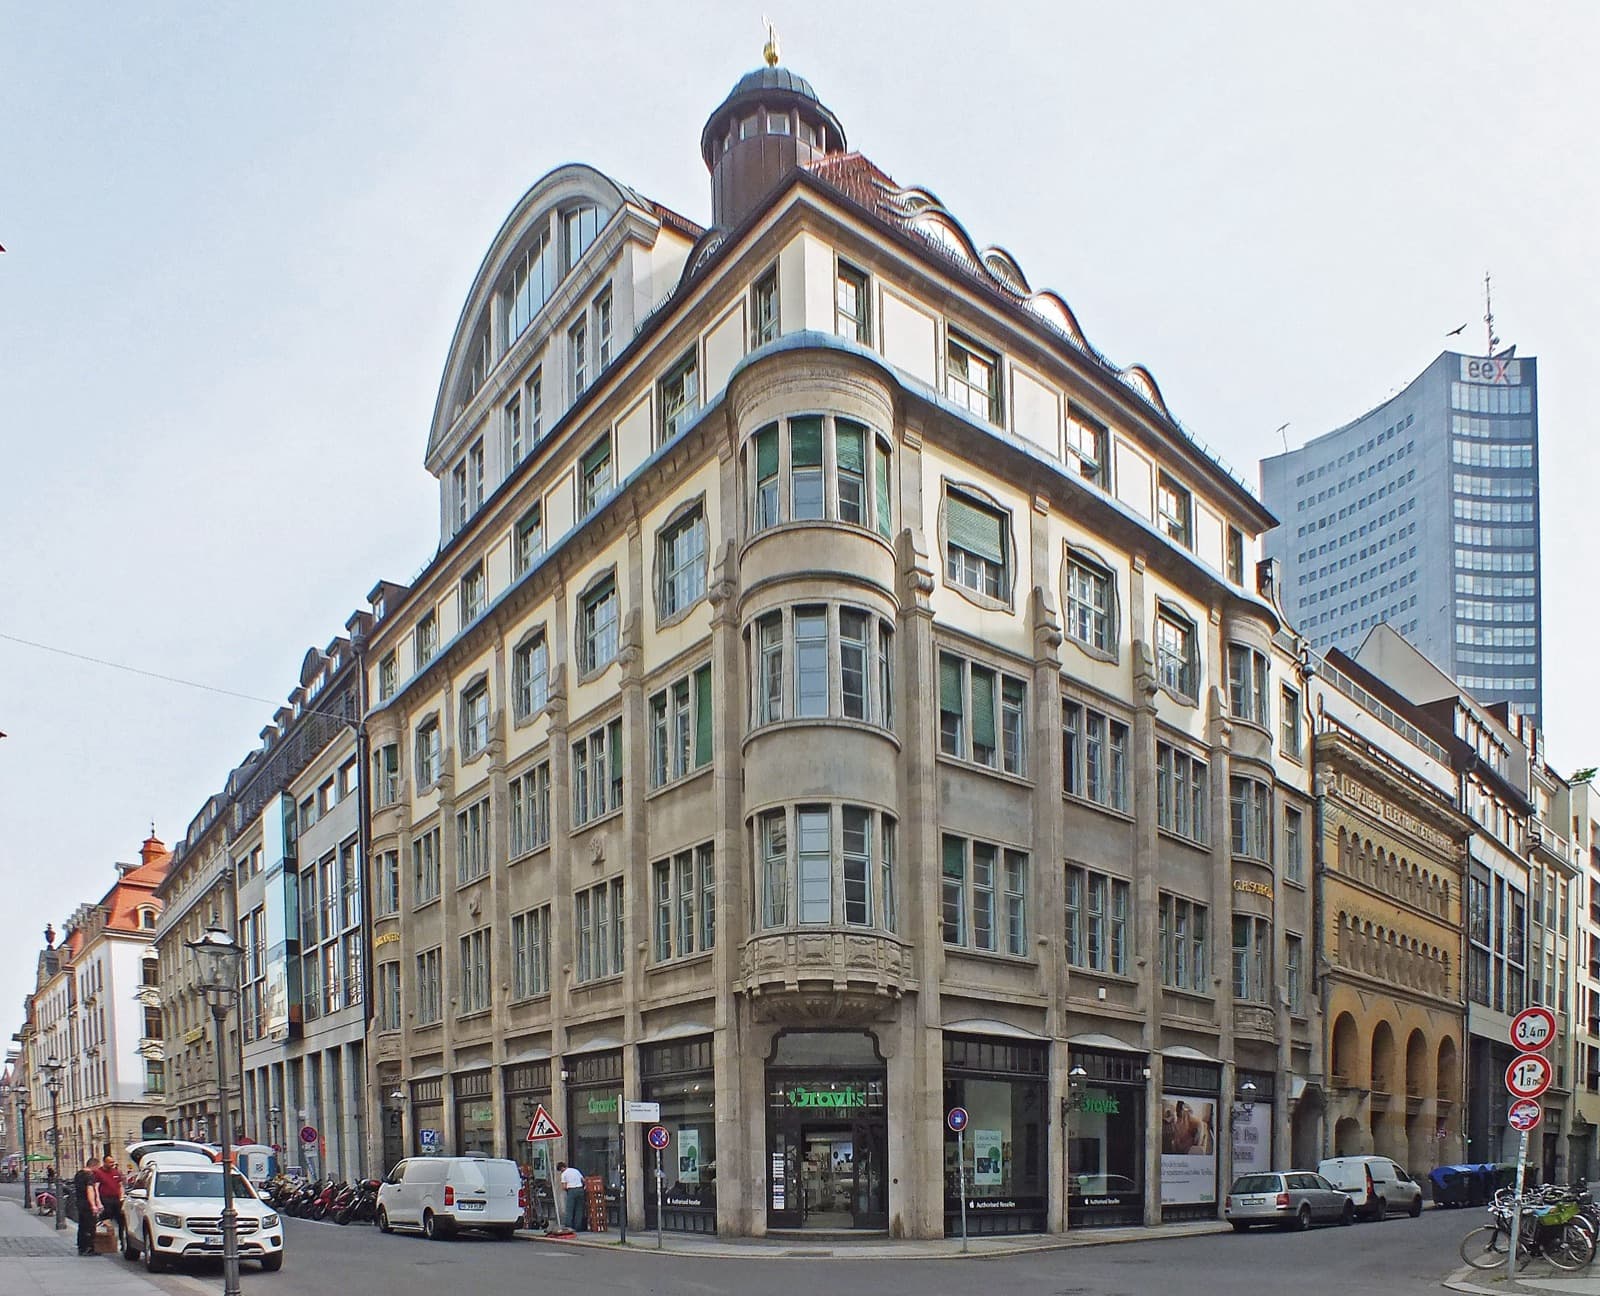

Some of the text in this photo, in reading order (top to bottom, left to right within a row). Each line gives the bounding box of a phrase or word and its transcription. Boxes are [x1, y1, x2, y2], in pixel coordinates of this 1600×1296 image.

[1468, 358, 1511, 385] eex
[1345, 779, 1382, 815] LEIPZIGER
[789, 1086, 865, 1108] Gravis
